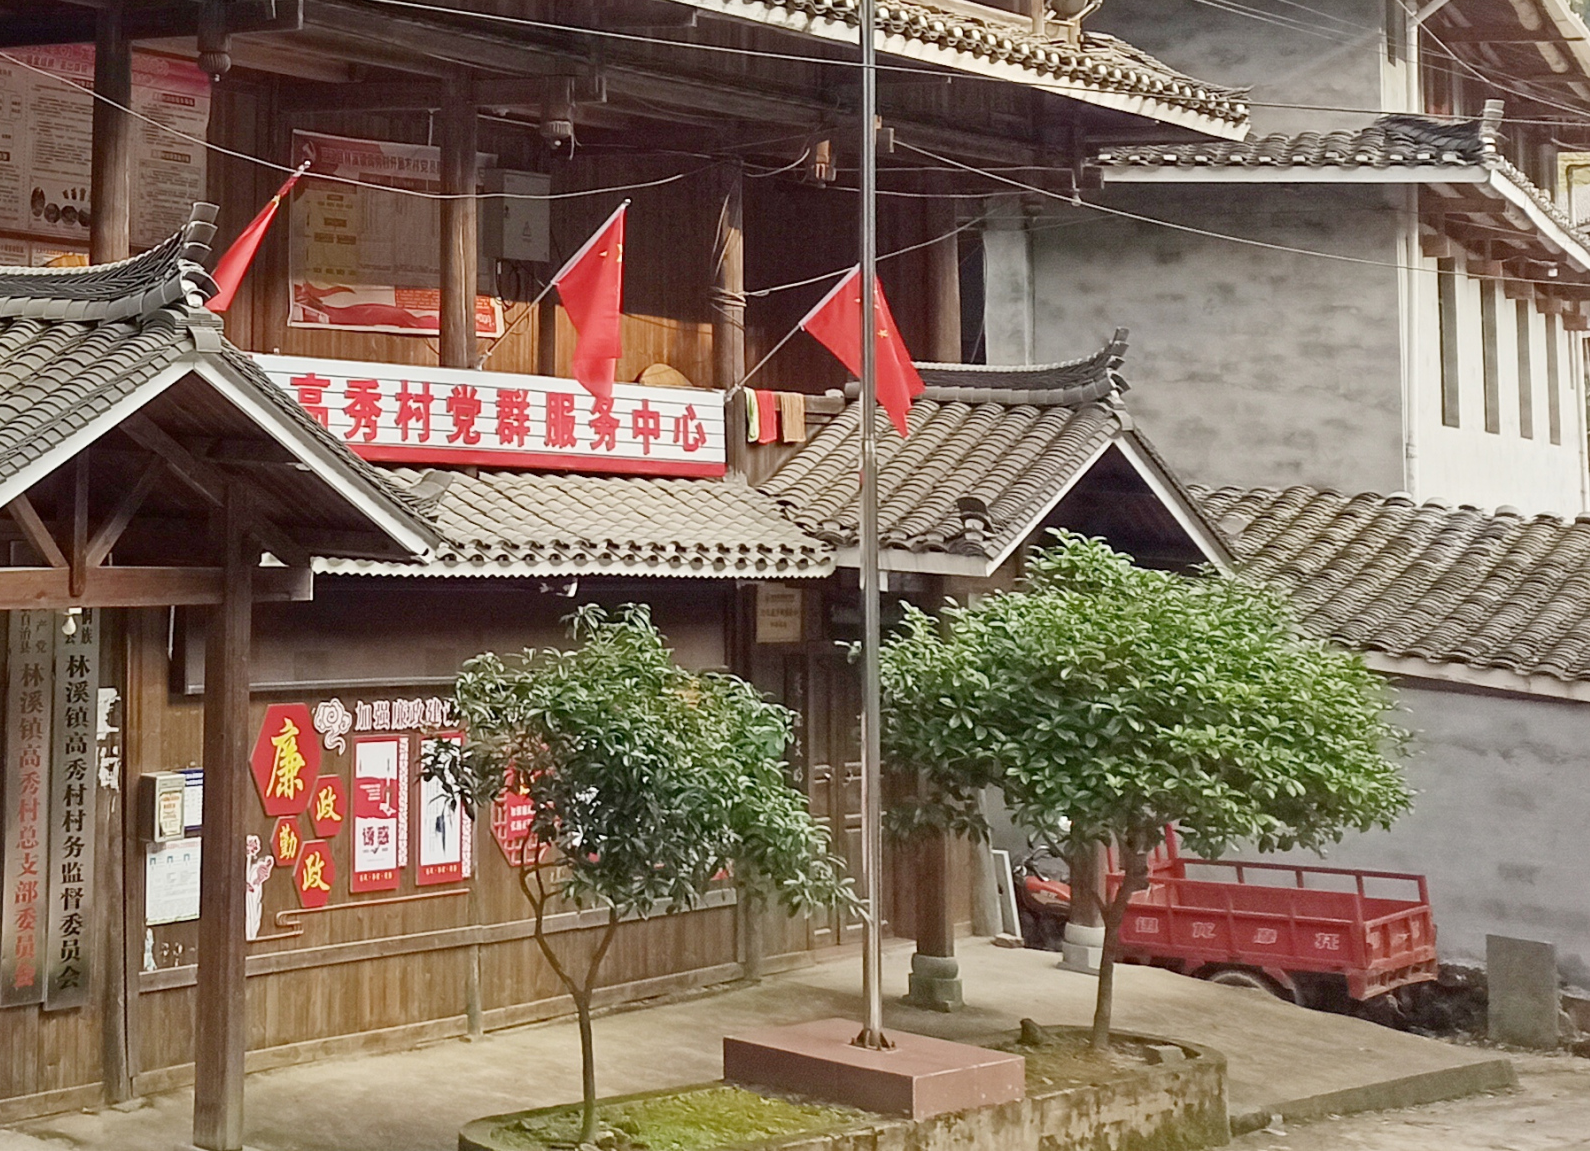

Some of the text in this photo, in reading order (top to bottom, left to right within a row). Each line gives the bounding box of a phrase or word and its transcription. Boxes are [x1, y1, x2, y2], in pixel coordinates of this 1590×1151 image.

[291, 373, 706, 454] 高秀村党群服务中心
[267, 719, 306, 799] 廉
[14, 663, 46, 988] 林溪镇高秀村总支部委员会
[58, 655, 91, 990] 林溪镇高秀村村务监督委员会
[278, 823, 297, 859] 勤
[318, 786, 341, 821] 政
[302, 852, 332, 891] 政
